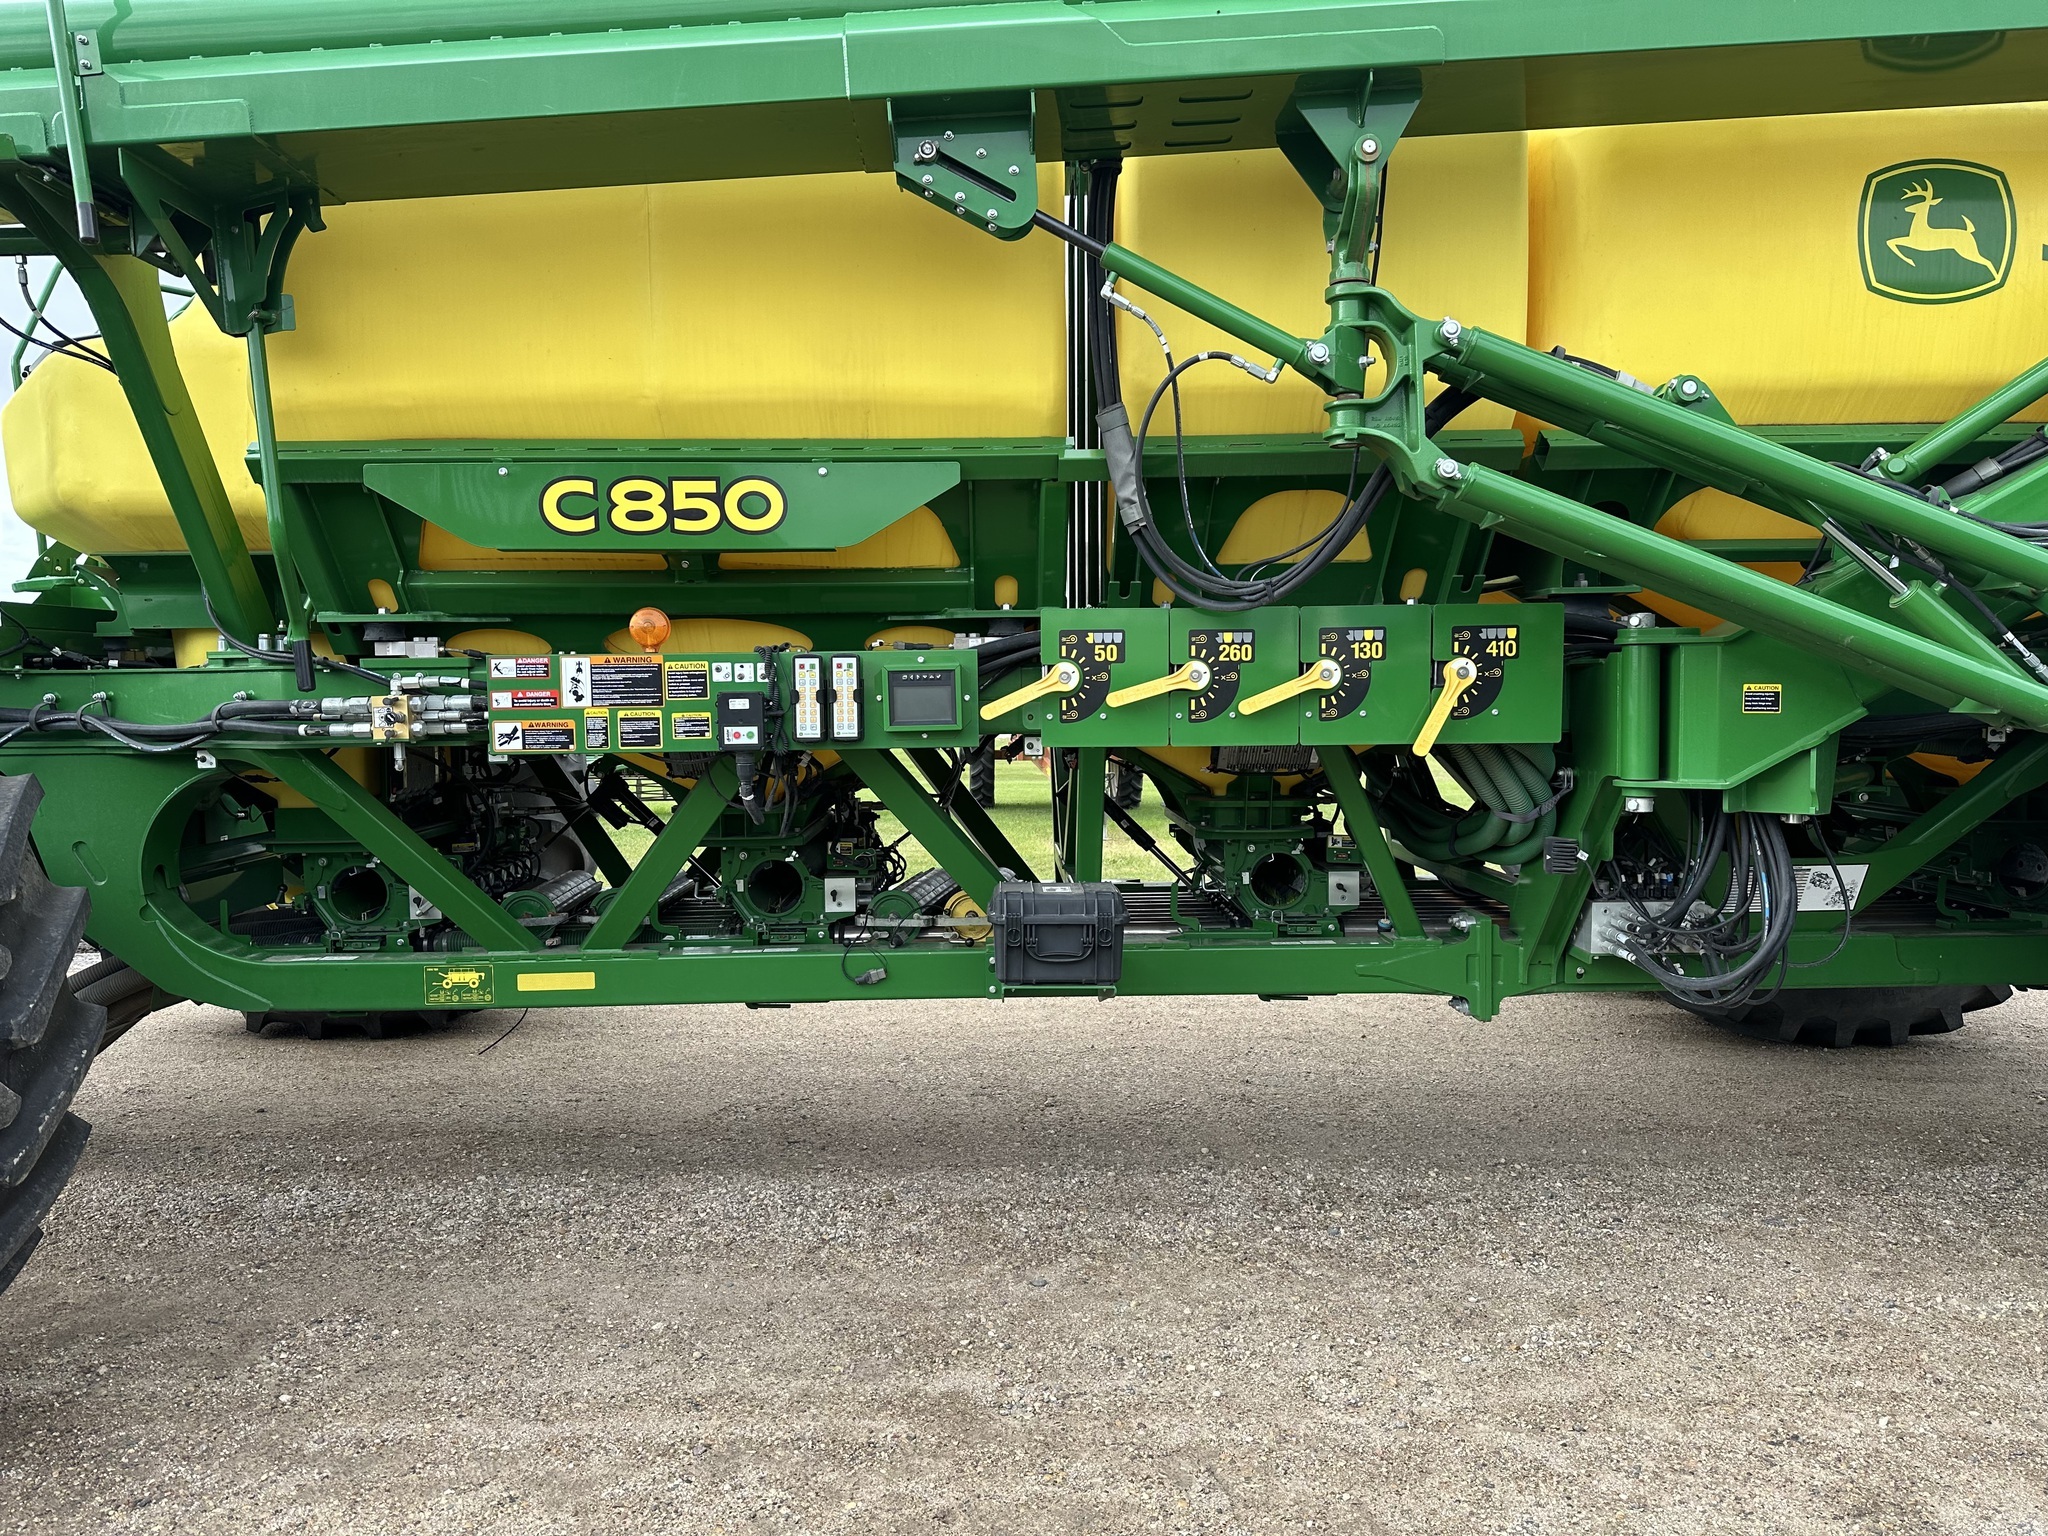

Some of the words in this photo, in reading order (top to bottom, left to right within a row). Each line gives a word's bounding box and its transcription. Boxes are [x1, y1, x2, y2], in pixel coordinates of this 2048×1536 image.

[1094, 644, 1118, 662] 50
[1218, 644, 1253, 662] 260
[1350, 642, 1383, 659] 130
[1485, 640, 1517, 657] 410
